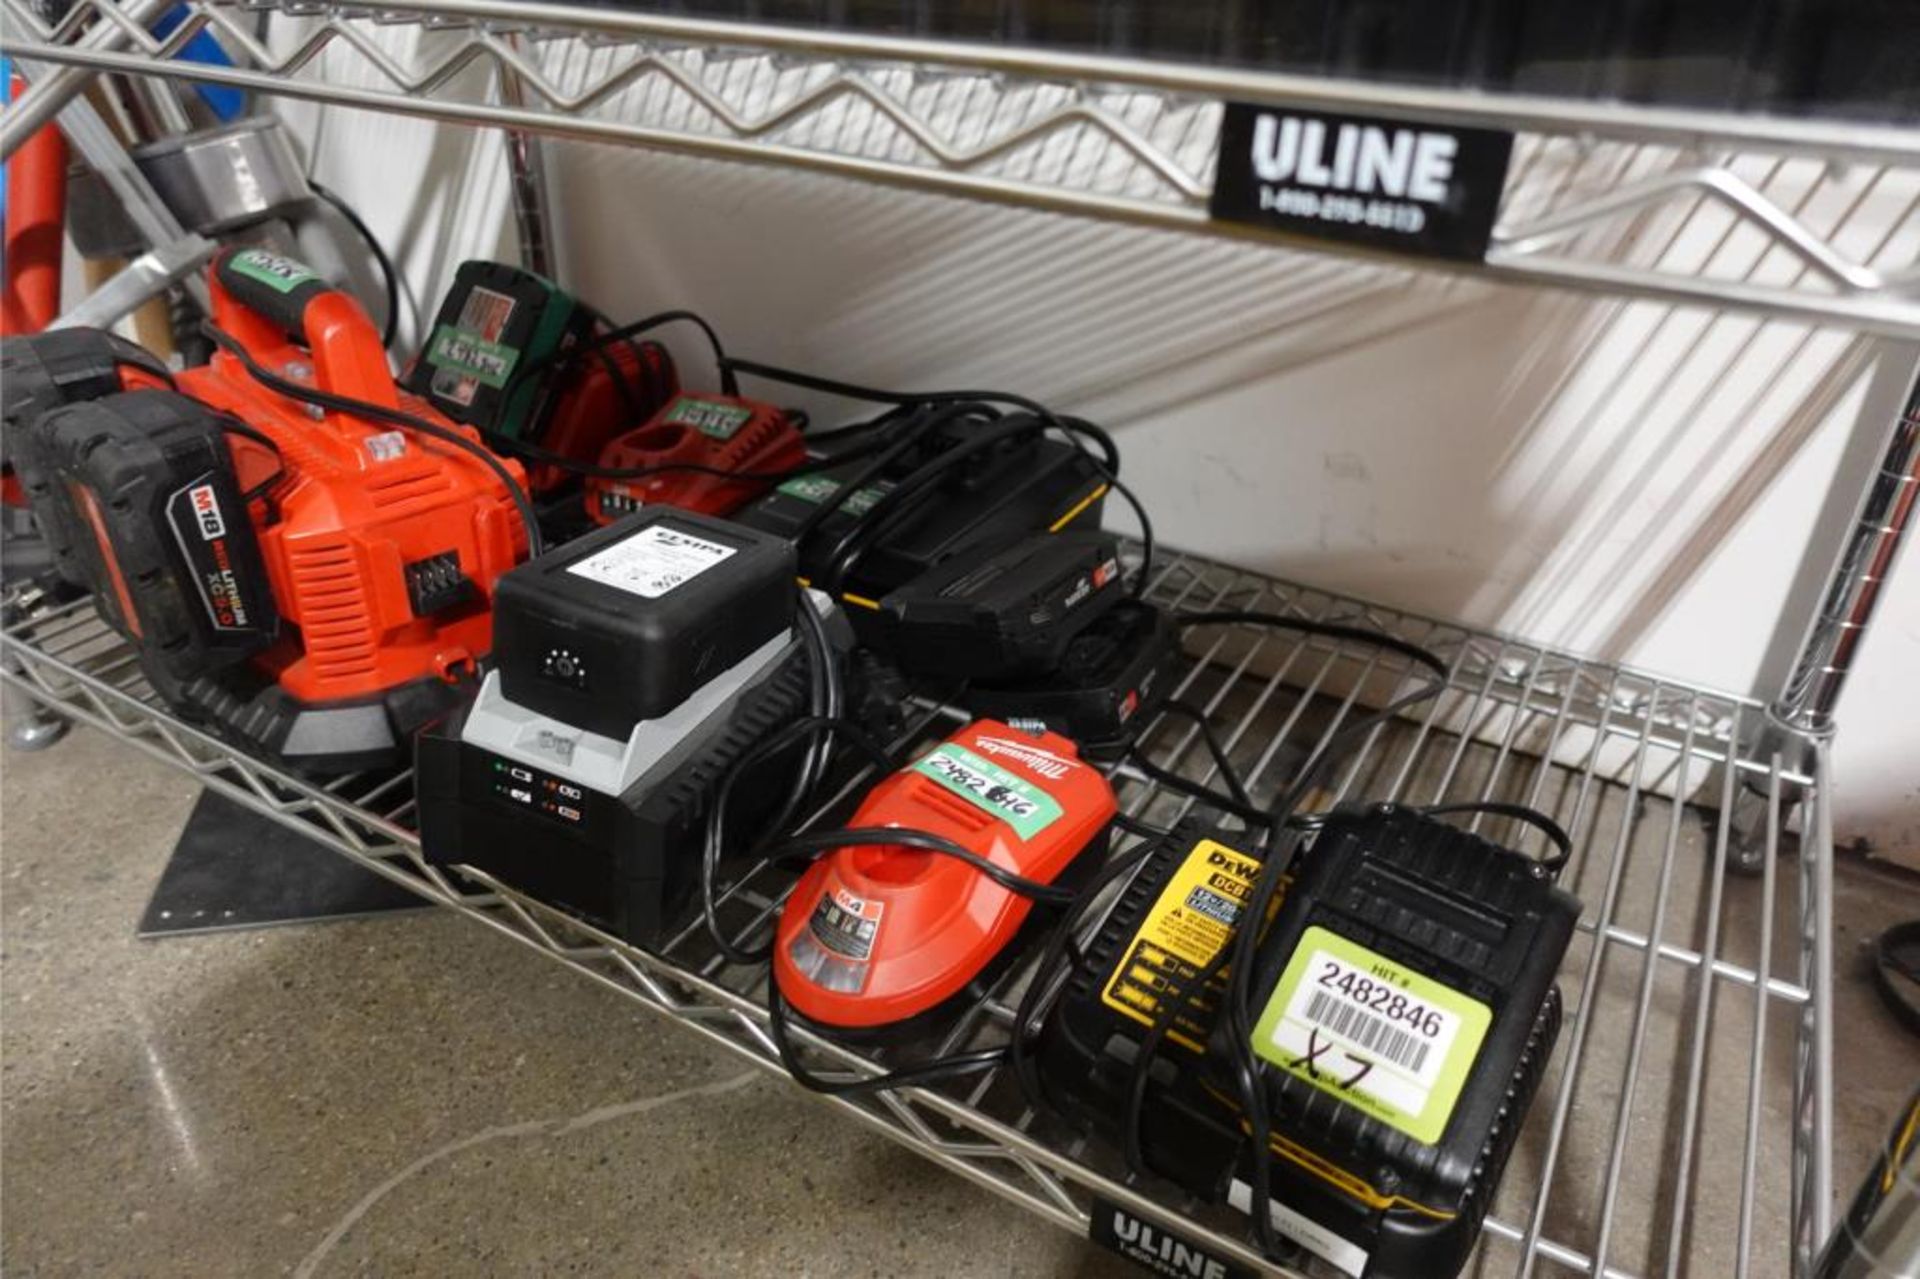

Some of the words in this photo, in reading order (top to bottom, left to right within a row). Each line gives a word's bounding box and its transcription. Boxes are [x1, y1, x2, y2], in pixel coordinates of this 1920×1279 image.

[1251, 113, 1458, 202] ULINE
[193, 489, 221, 534] M18
[975, 736, 1074, 781] Milwaukee
[1207, 848, 1260, 883] DEW
[1371, 964, 1397, 983] HIT
[1317, 961, 1444, 1039] 2482846
[1113, 1210, 1227, 1279] ULINE
